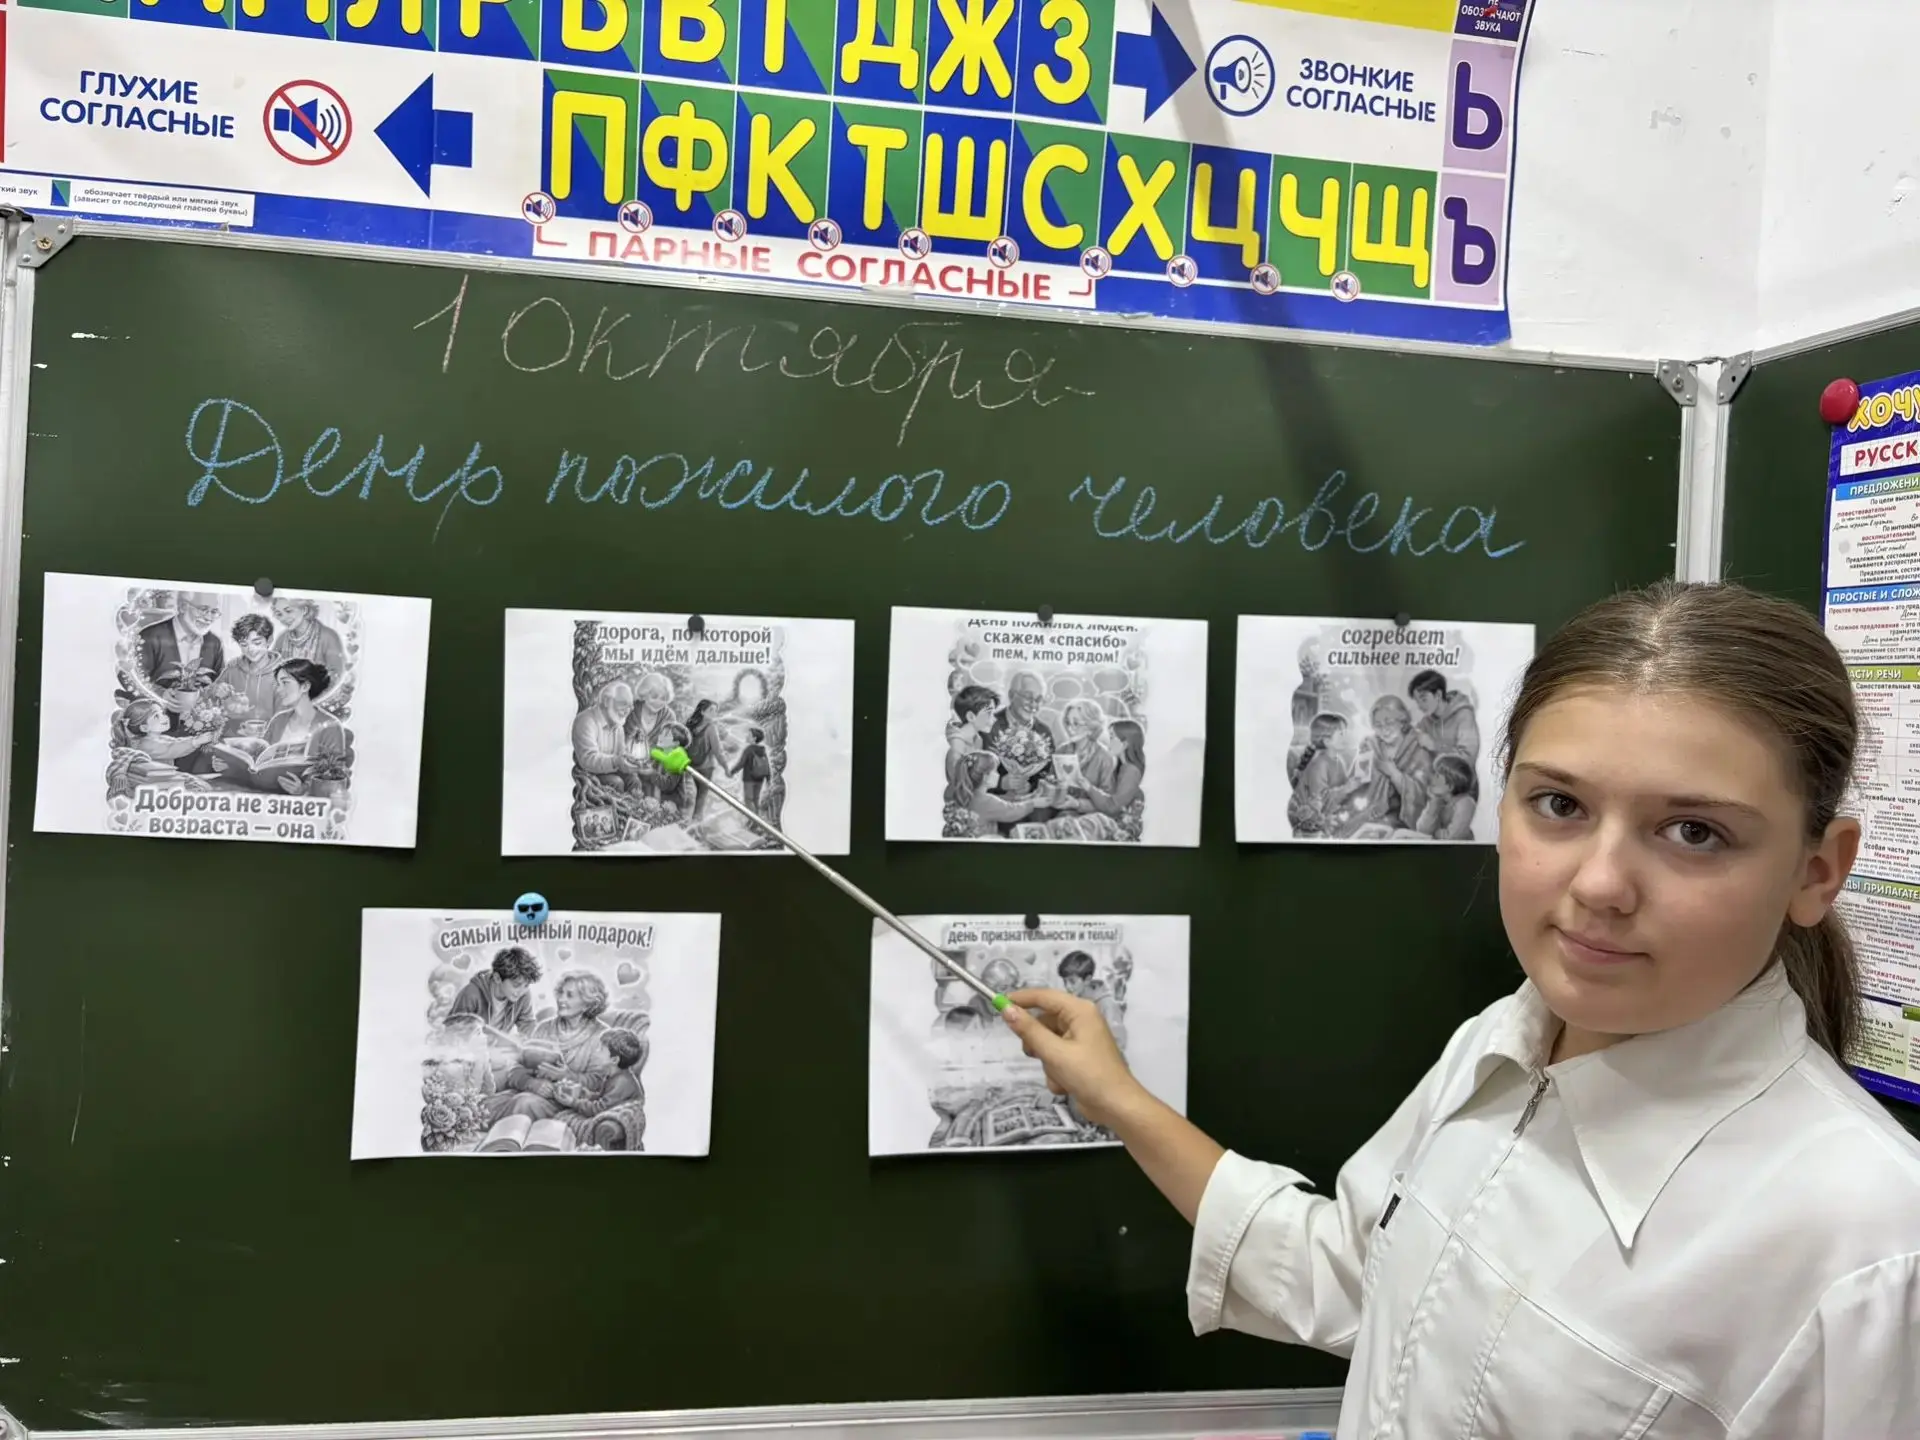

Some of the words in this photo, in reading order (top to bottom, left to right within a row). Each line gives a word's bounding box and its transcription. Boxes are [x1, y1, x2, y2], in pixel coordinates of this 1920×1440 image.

[1461, 5, 1521, 22] ОБОЗАЧАЮТ
[1475, 20, 1501, 32] ЗВУКА
[840, 0, 918, 90] Д
[929, 0, 1012, 99] Ж
[1033, 0, 1090, 104] З
[1299, 58, 1414, 92] ЗВОНКИЕ
[80, 70, 198, 105] ГЛУХИЕ
[1286, 84, 1436, 123] СОГЛАСНЫЕ
[40, 97, 234, 139] СОГЛАСНЫЕ
[18, 187, 38, 195] звук
[84, 188, 131, 198] обозначает
[134, 193, 169, 201] твёрдый
[190, 197, 218, 205] мягкий
[550, 91, 627, 204] П
[642, 101, 728, 212] Ф
[747, 113, 816, 224] К
[848, 124, 908, 230] Т
[921, 133, 1007, 242] Ш
[1022, 144, 1089, 250] С
[1106, 154, 1176, 261] Х
[1191, 162, 1260, 269] Ц
[1279, 173, 1340, 277] Ч
[1351, 181, 1430, 289] Щ
[74, 195, 110, 204] (зависит
[123, 200, 181, 210] последующей
[219, 207, 248, 216] буквы)
[588, 231, 771, 274] ПАРНЫЕ
[797, 250, 1051, 301] СОГЛАСНЫЕ
[413, 274, 468, 373] 1
[1855, 439, 1918, 467] РУССК
[186, 398, 503, 538] День
[547, 449, 1010, 529] пожилого
[1069, 469, 1526, 558] человека
[1850, 477, 1919, 496] ПРЕДЛОЖЕНИ
[1833, 591, 1877, 602] ПРОСТЫЕ
[1880, 590, 1888, 599] И
[1891, 588, 1920, 598] СЛОЖ
[597, 626, 665, 643] дорога,
[672, 627, 693, 642] по
[700, 626, 771, 644] которой
[983, 631, 1044, 646] скажем
[1050, 634, 1127, 649] «спасибо»
[1342, 627, 1444, 649] согревает
[604, 648, 634, 662] мы
[641, 645, 689, 664] идём
[696, 647, 770, 664] дальше!
[992, 648, 1028, 661] тем,
[1033, 650, 1063, 662] кто
[1067, 650, 1119, 664] рядом!
[1328, 650, 1400, 665] сильнее
[1405, 647, 1460, 666] пледа!
[1849, 669, 1873, 679] АСТИ
[1877, 669, 1902, 679] РЕЧИ
[135, 789, 231, 814] Доброта
[237, 797, 261, 813] не
[268, 798, 327, 817] знает
[150, 817, 248, 837] возраста
[277, 822, 315, 839] она
[1863, 882, 1920, 899] ПРИЛАГАТЕ
[440, 922, 501, 949] самый
[508, 920, 572, 943] ценный
[578, 925, 653, 949] подарок!
[948, 930, 978, 944] день
[981, 929, 1075, 945] признательности
[1078, 931, 1085, 940] и
[1088, 929, 1118, 941] тепла!
